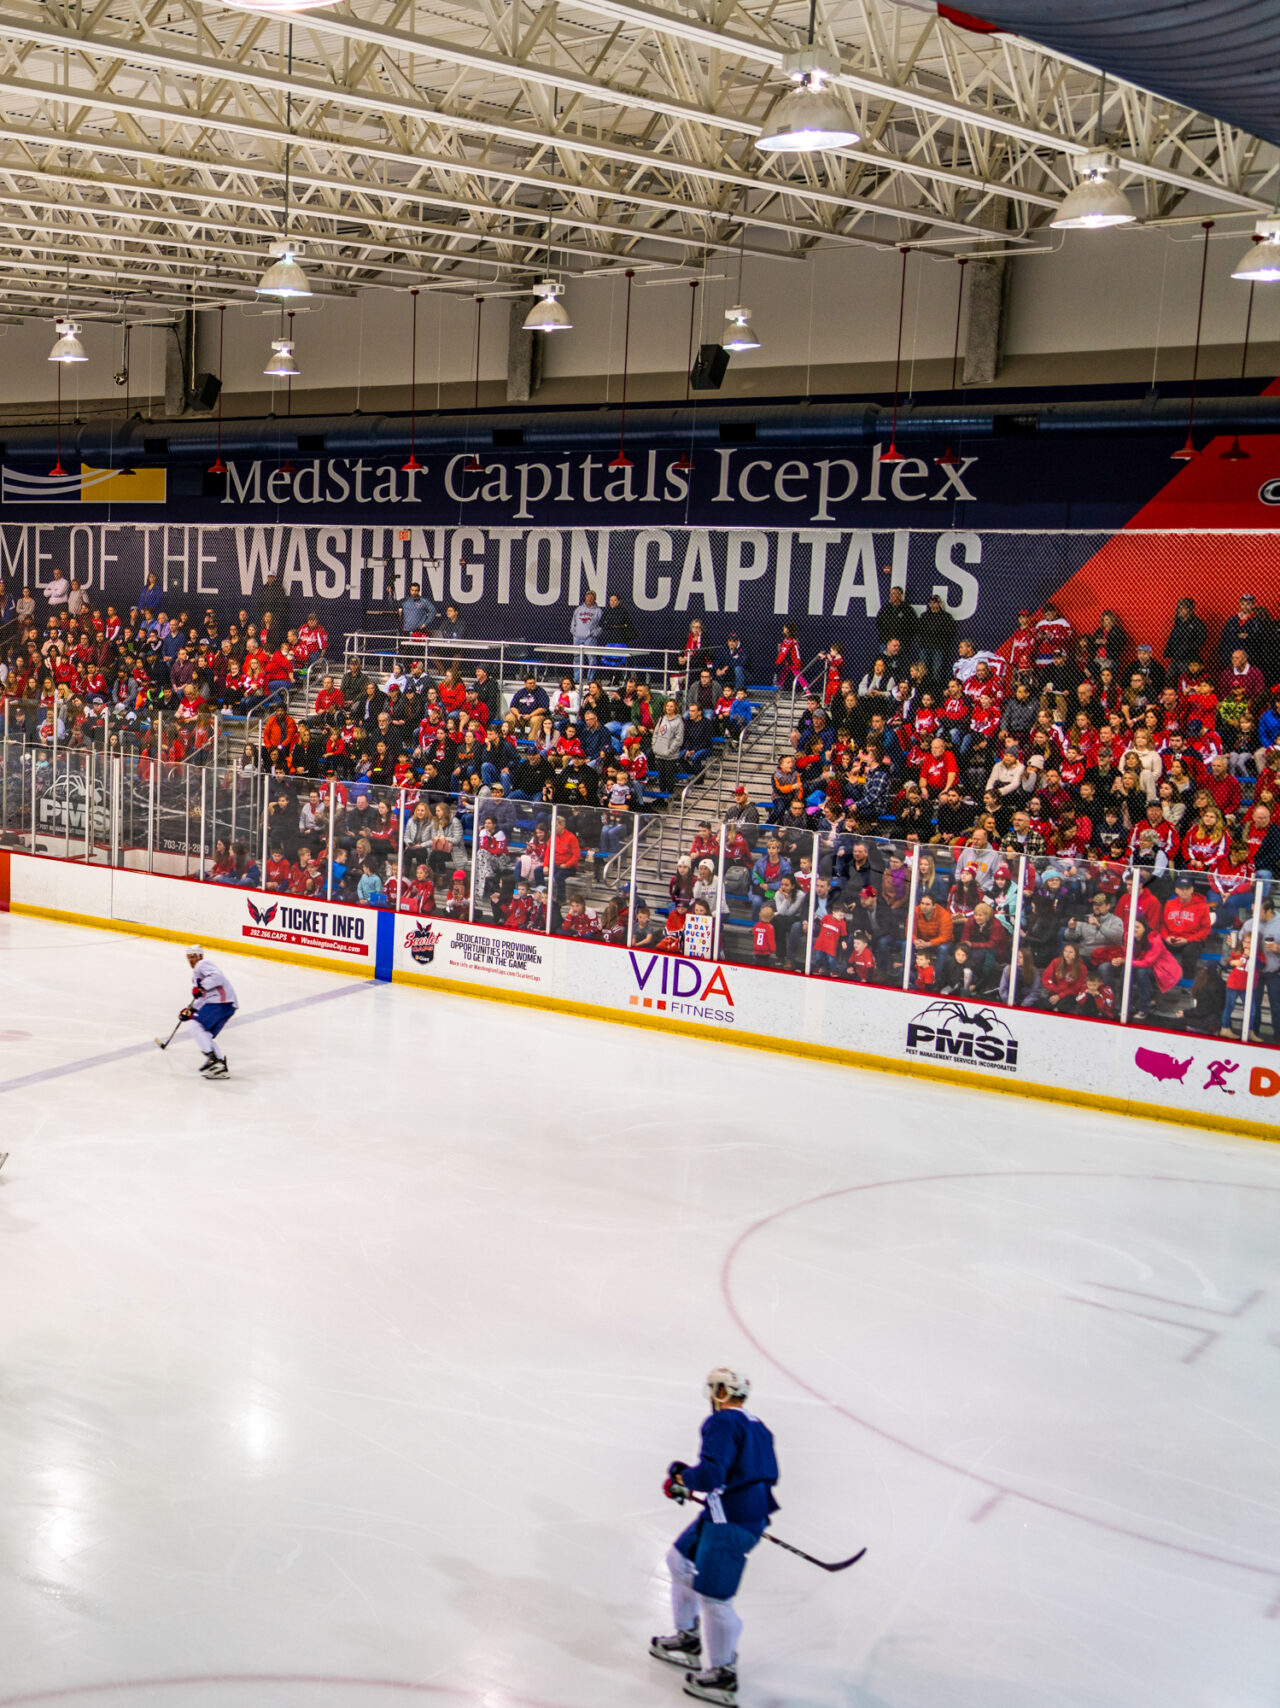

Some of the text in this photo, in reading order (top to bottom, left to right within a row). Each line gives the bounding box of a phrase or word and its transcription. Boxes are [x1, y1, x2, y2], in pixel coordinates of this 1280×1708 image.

[221, 442, 979, 521] MedStar Capitals Iceplex
[71, 526, 120, 591] OF
[135, 526, 219, 594] THE
[235, 527, 610, 608] WASHINGTON
[633, 531, 982, 621] CAPITALS
[280, 906, 364, 940] TICKET INFO
[301, 937, 361, 952] WashingtonCaps.com
[404, 931, 443, 948] Scarlet
[456, 932, 537, 955] DEDICATED TO PROVIDING
[757, 933, 764, 946] 8
[450, 941, 542, 964] OPPORTUNITIES FOR WOMEN
[463, 950, 527, 971] TO GET IN THE GAME
[628, 951, 734, 1006] VIDA
[671, 1002, 734, 1023] FITNESS
[906, 1048, 1017, 1072] PEST MANAGEMENT SERVICES INCORPORATED
[1249, 1066, 1280, 1097] D
